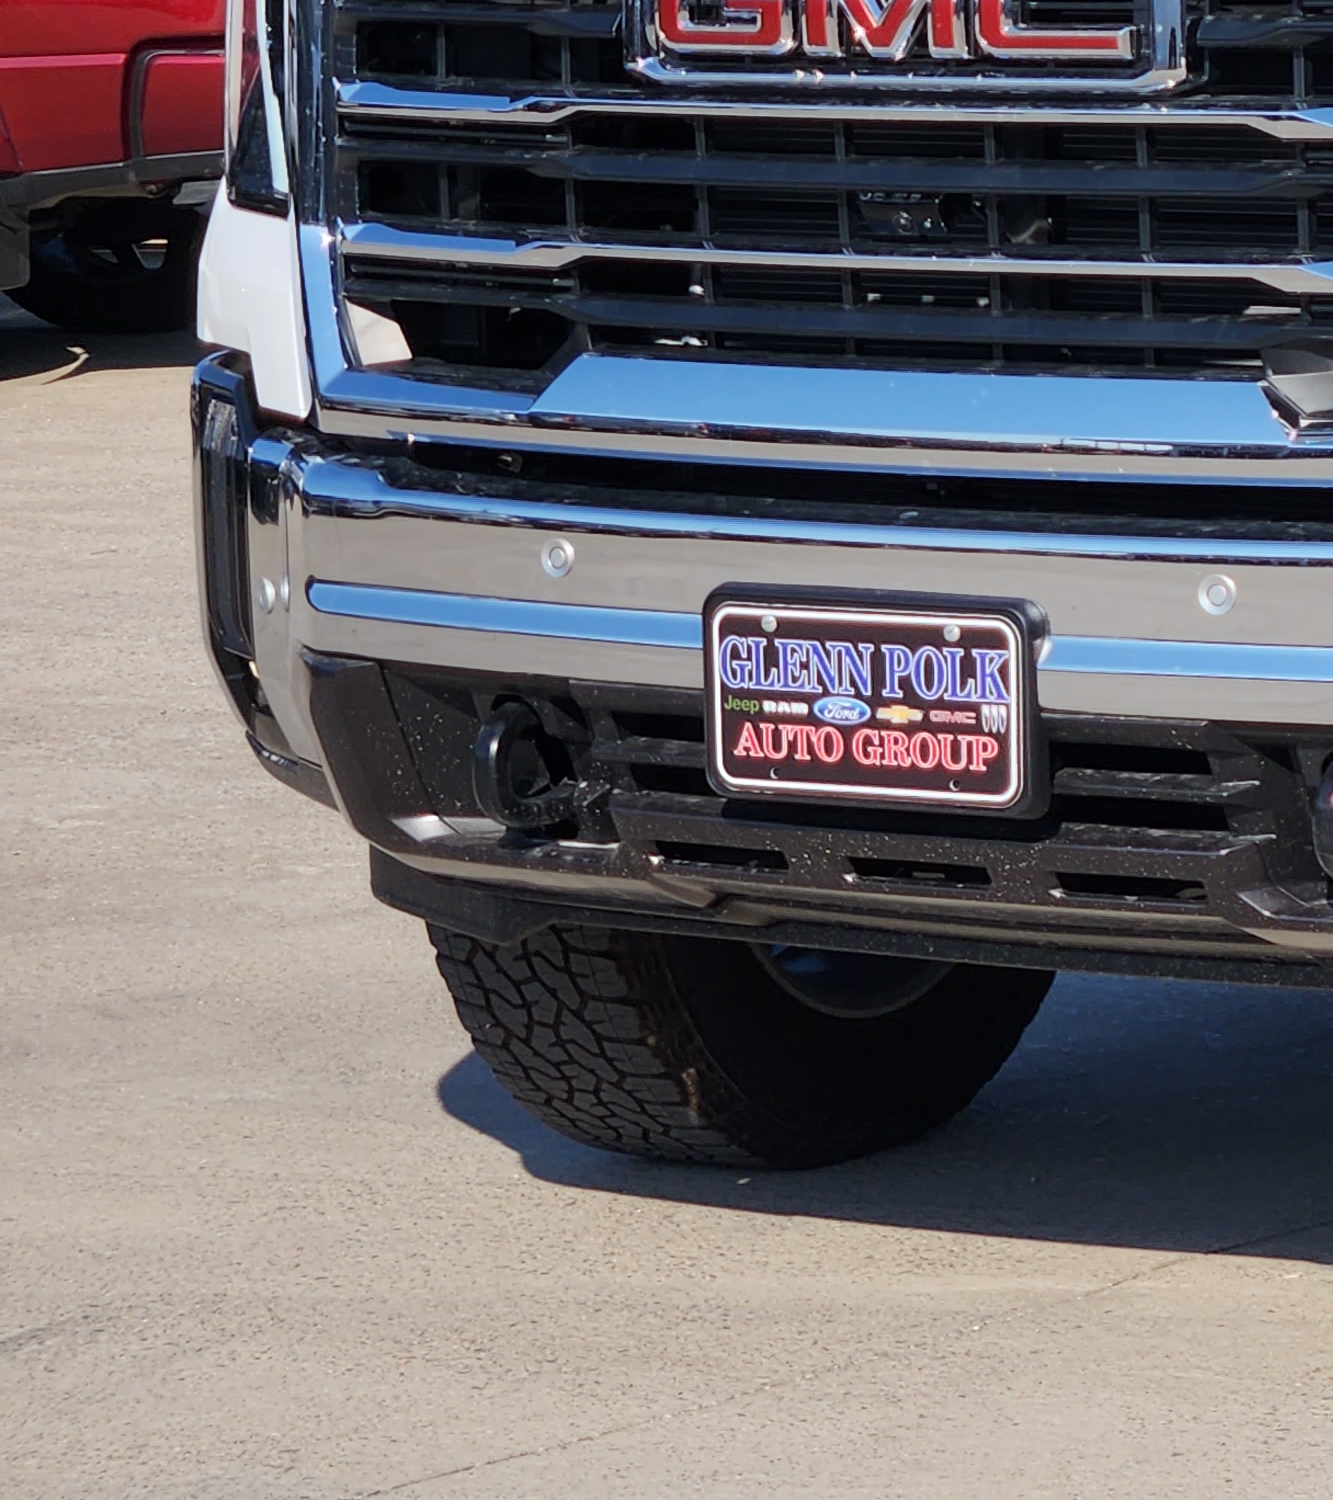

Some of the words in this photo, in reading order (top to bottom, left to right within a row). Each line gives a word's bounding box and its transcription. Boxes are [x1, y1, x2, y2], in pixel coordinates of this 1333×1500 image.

[719, 634, 875, 697] GLENN
[881, 643, 1011, 703] POLK
[724, 695, 760, 715] Jeep
[762, 700, 809, 716] RAM
[823, 701, 860, 720] Ford
[929, 710, 976, 725] GMC
[733, 721, 845, 763] AUTO
[852, 728, 999, 773] GROUP
